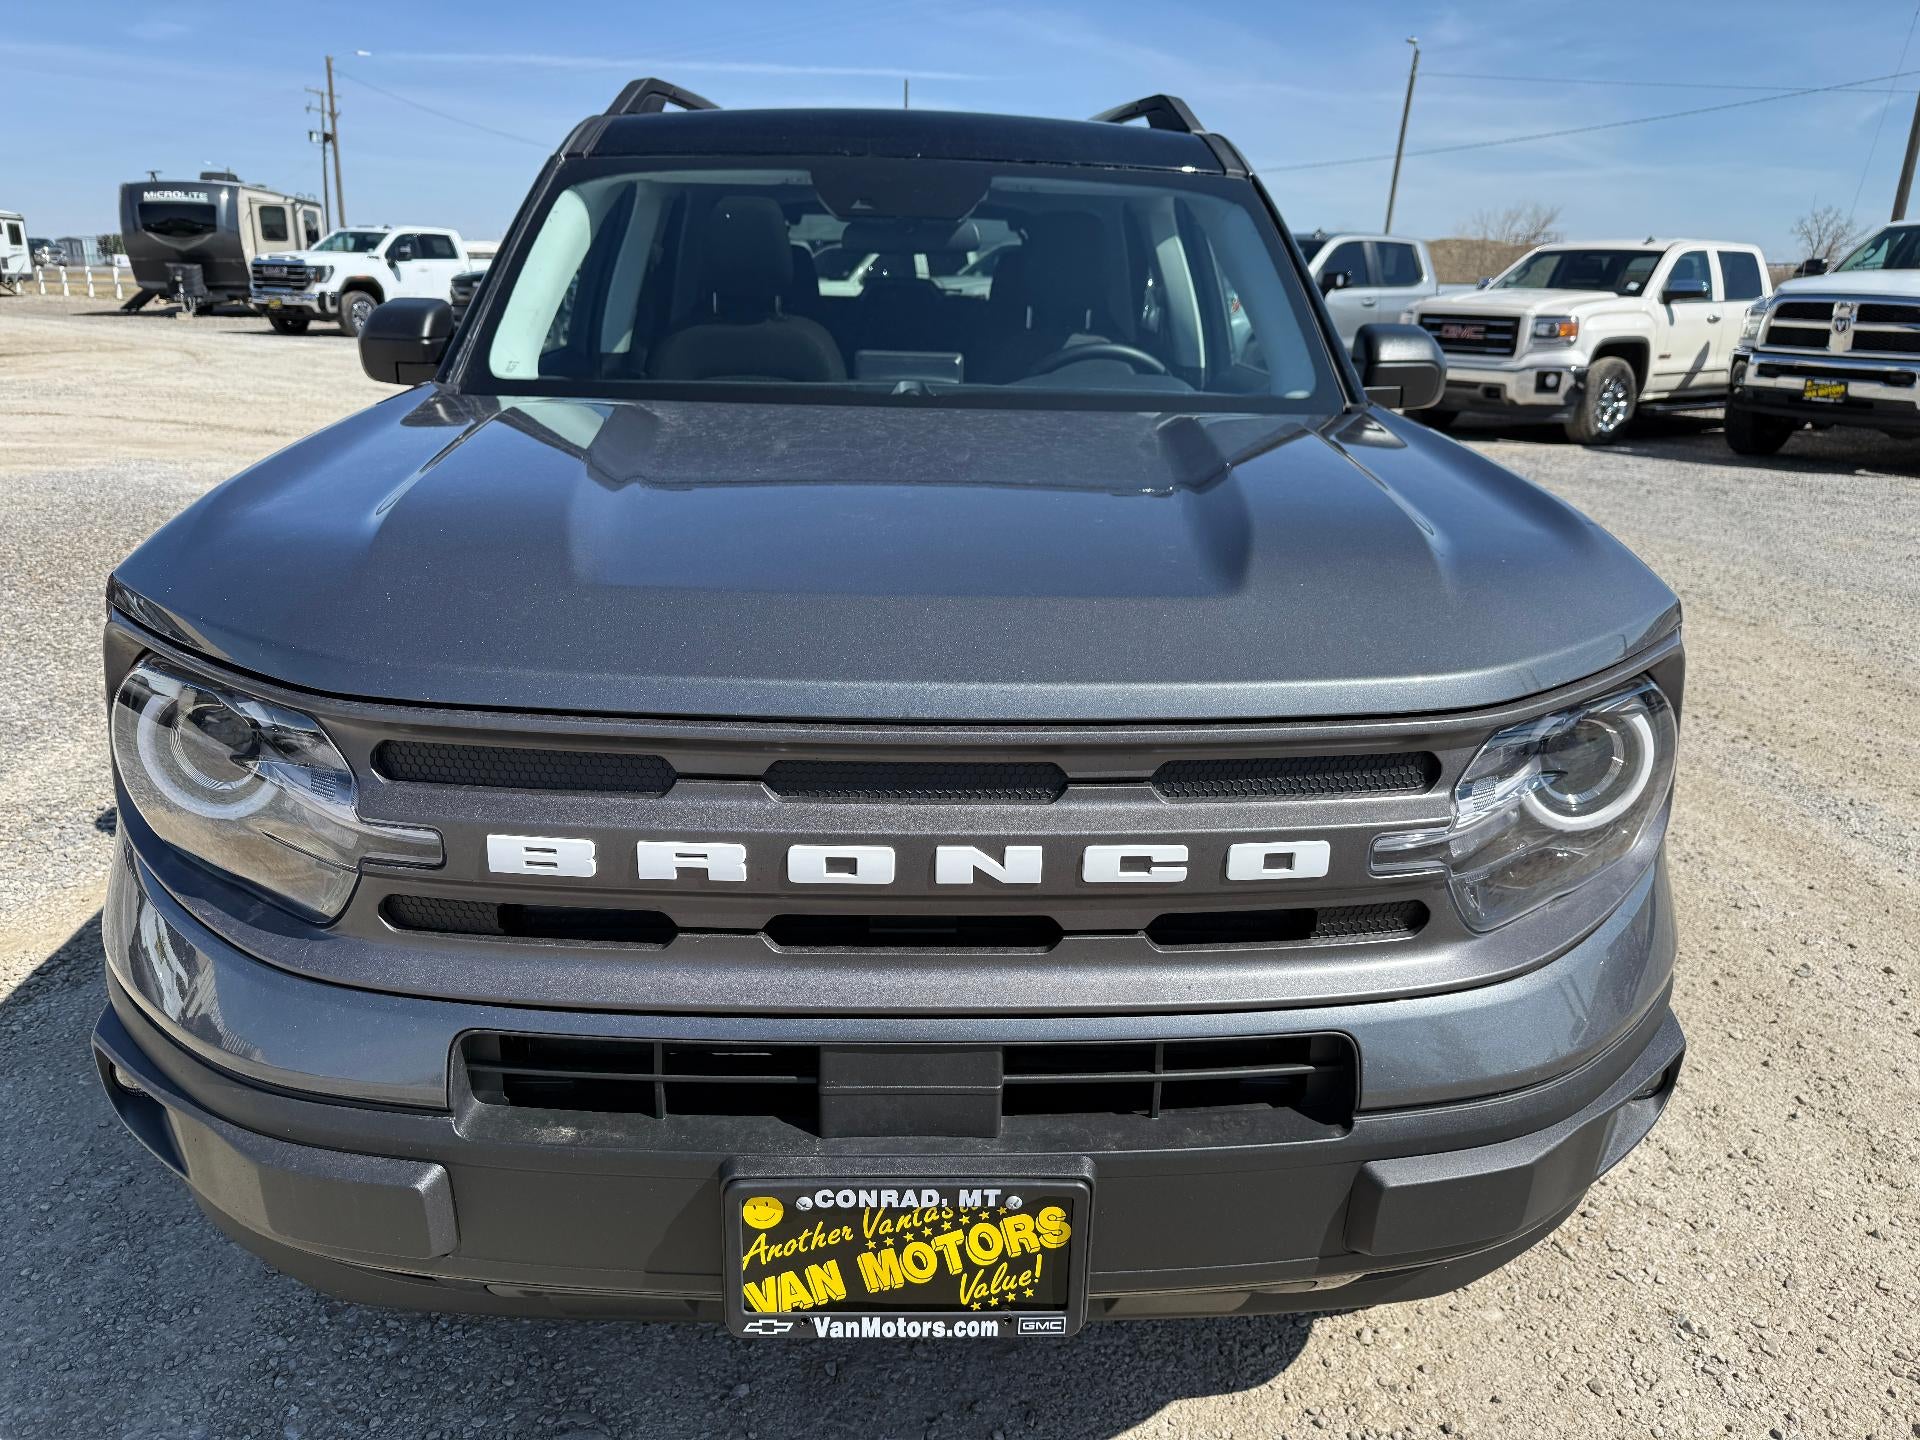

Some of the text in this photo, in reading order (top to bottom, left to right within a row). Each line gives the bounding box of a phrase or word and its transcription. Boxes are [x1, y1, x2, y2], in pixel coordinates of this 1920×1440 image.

[487, 834, 1331, 884] BRONCO
[815, 1189, 1001, 1208] CONRAD, MT
[742, 1221, 854, 1271] Another
[743, 1206, 1072, 1313] VAN MOTORS
[959, 1253, 1042, 1305] Value!
[813, 1316, 999, 1338] VanMotors.com
[1022, 1321, 1062, 1331] GMC
